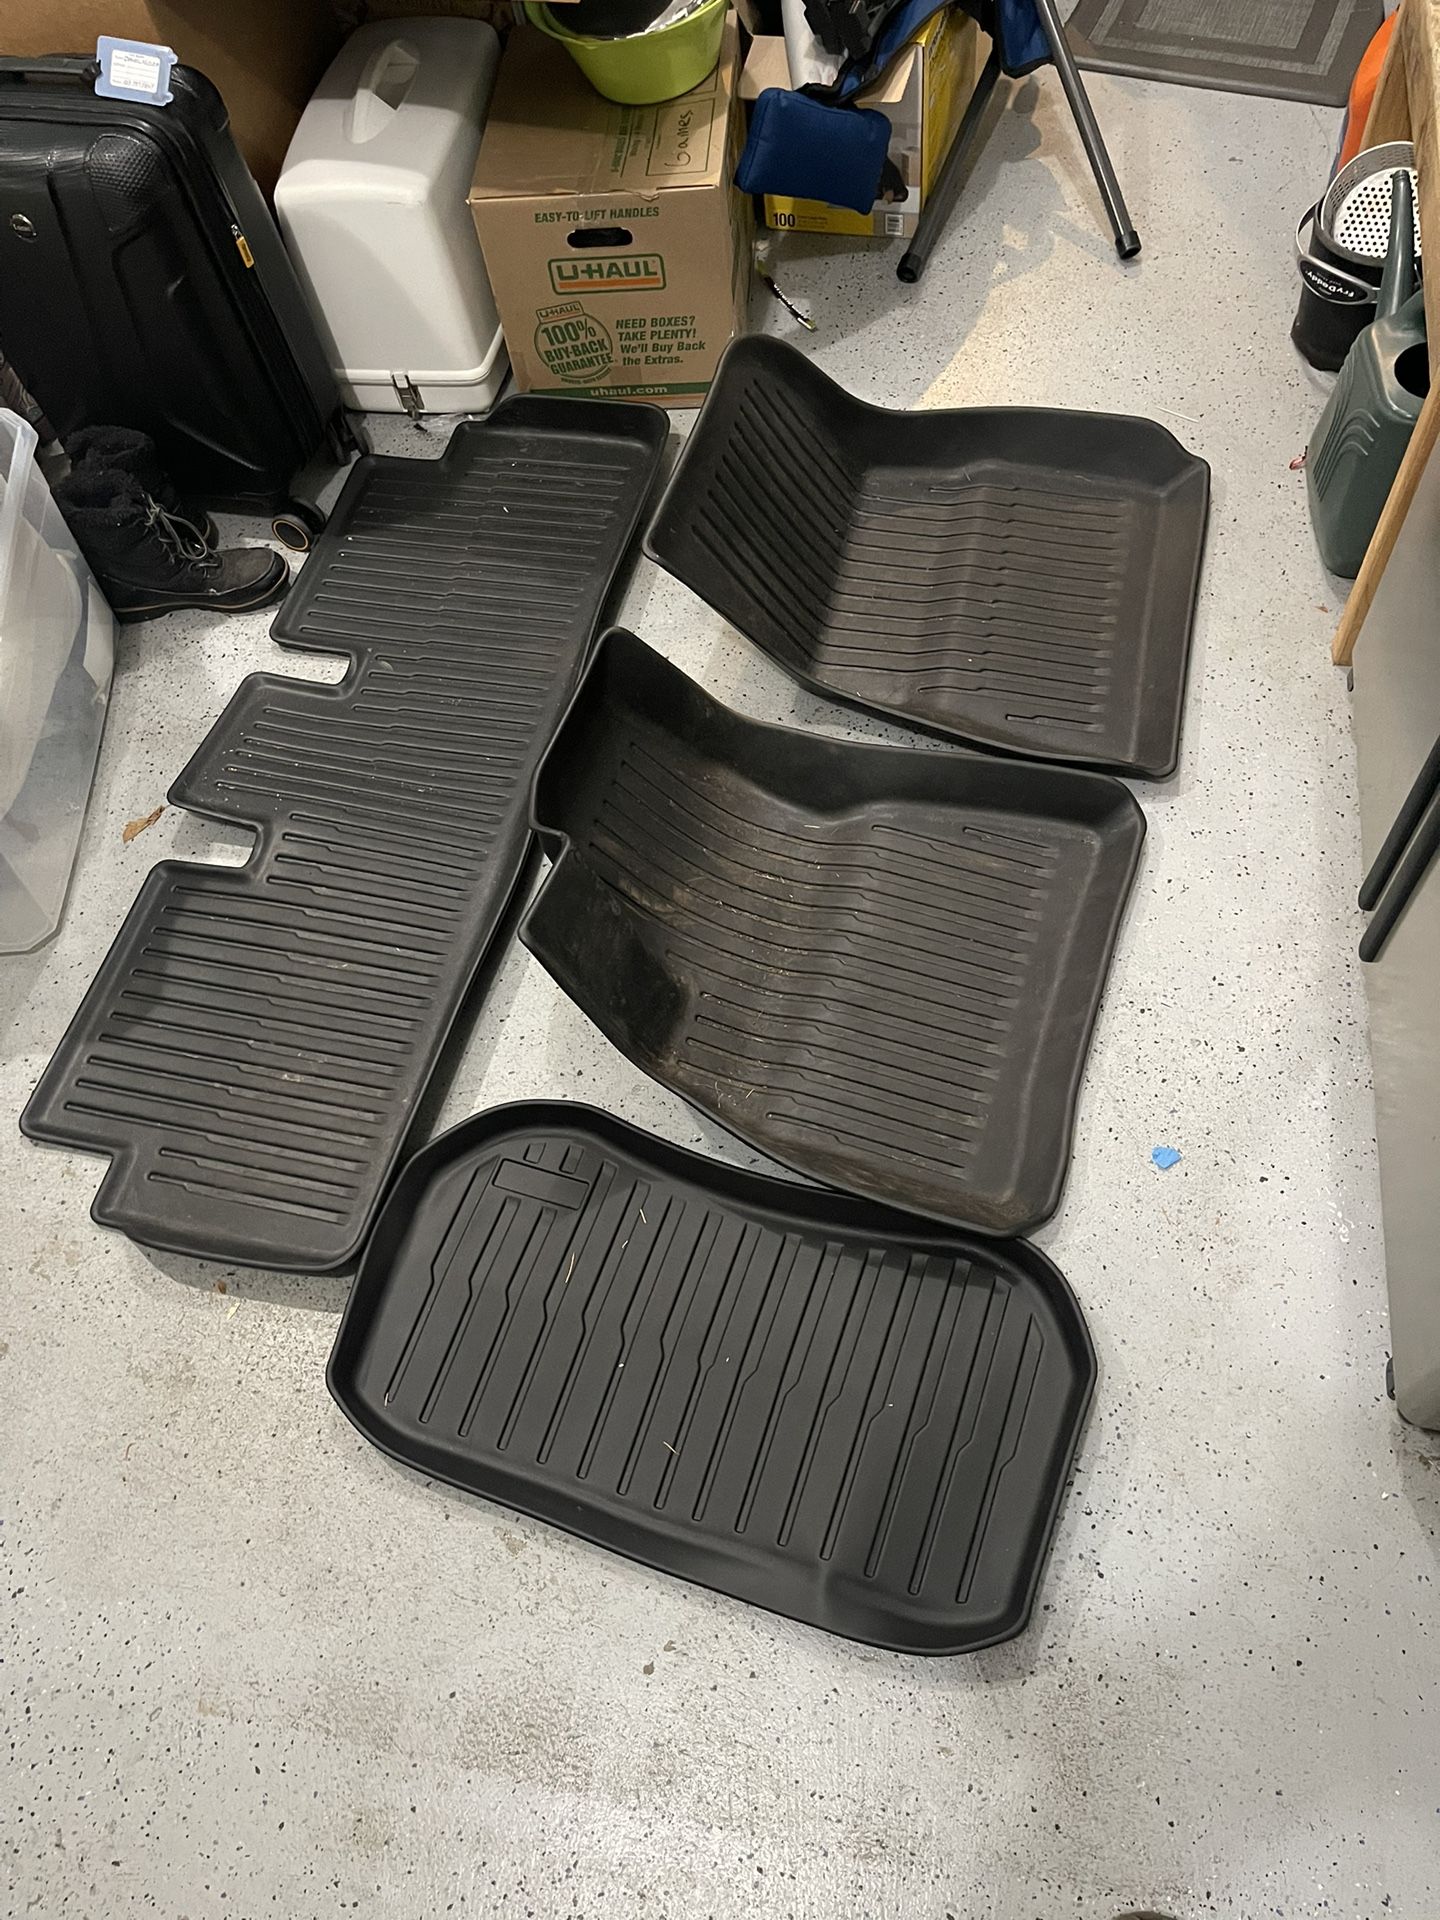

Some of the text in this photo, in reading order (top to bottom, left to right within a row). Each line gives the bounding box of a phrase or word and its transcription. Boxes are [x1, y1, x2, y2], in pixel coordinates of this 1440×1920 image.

[534, 206, 660, 223] EASY-TO-LIFT HANDLES
[773, 213, 796, 227] 100
[556, 260, 658, 280] U-HAUL
[1306, 270, 1355, 298] FryDaddy
[539, 304, 580, 318] U-HAUL
[615, 316, 696, 330] NEED BOXES?
[541, 317, 597, 346] 100%
[618, 328, 697, 341] TAKE PLENTY!
[544, 338, 608, 363] BUY-BACK
[620, 340, 706, 354] We'll Buy Back
[550, 352, 614, 375] GUARANTEE
[622, 354, 684, 366] the Extras.
[590, 386, 668, 397] uhaul.com
